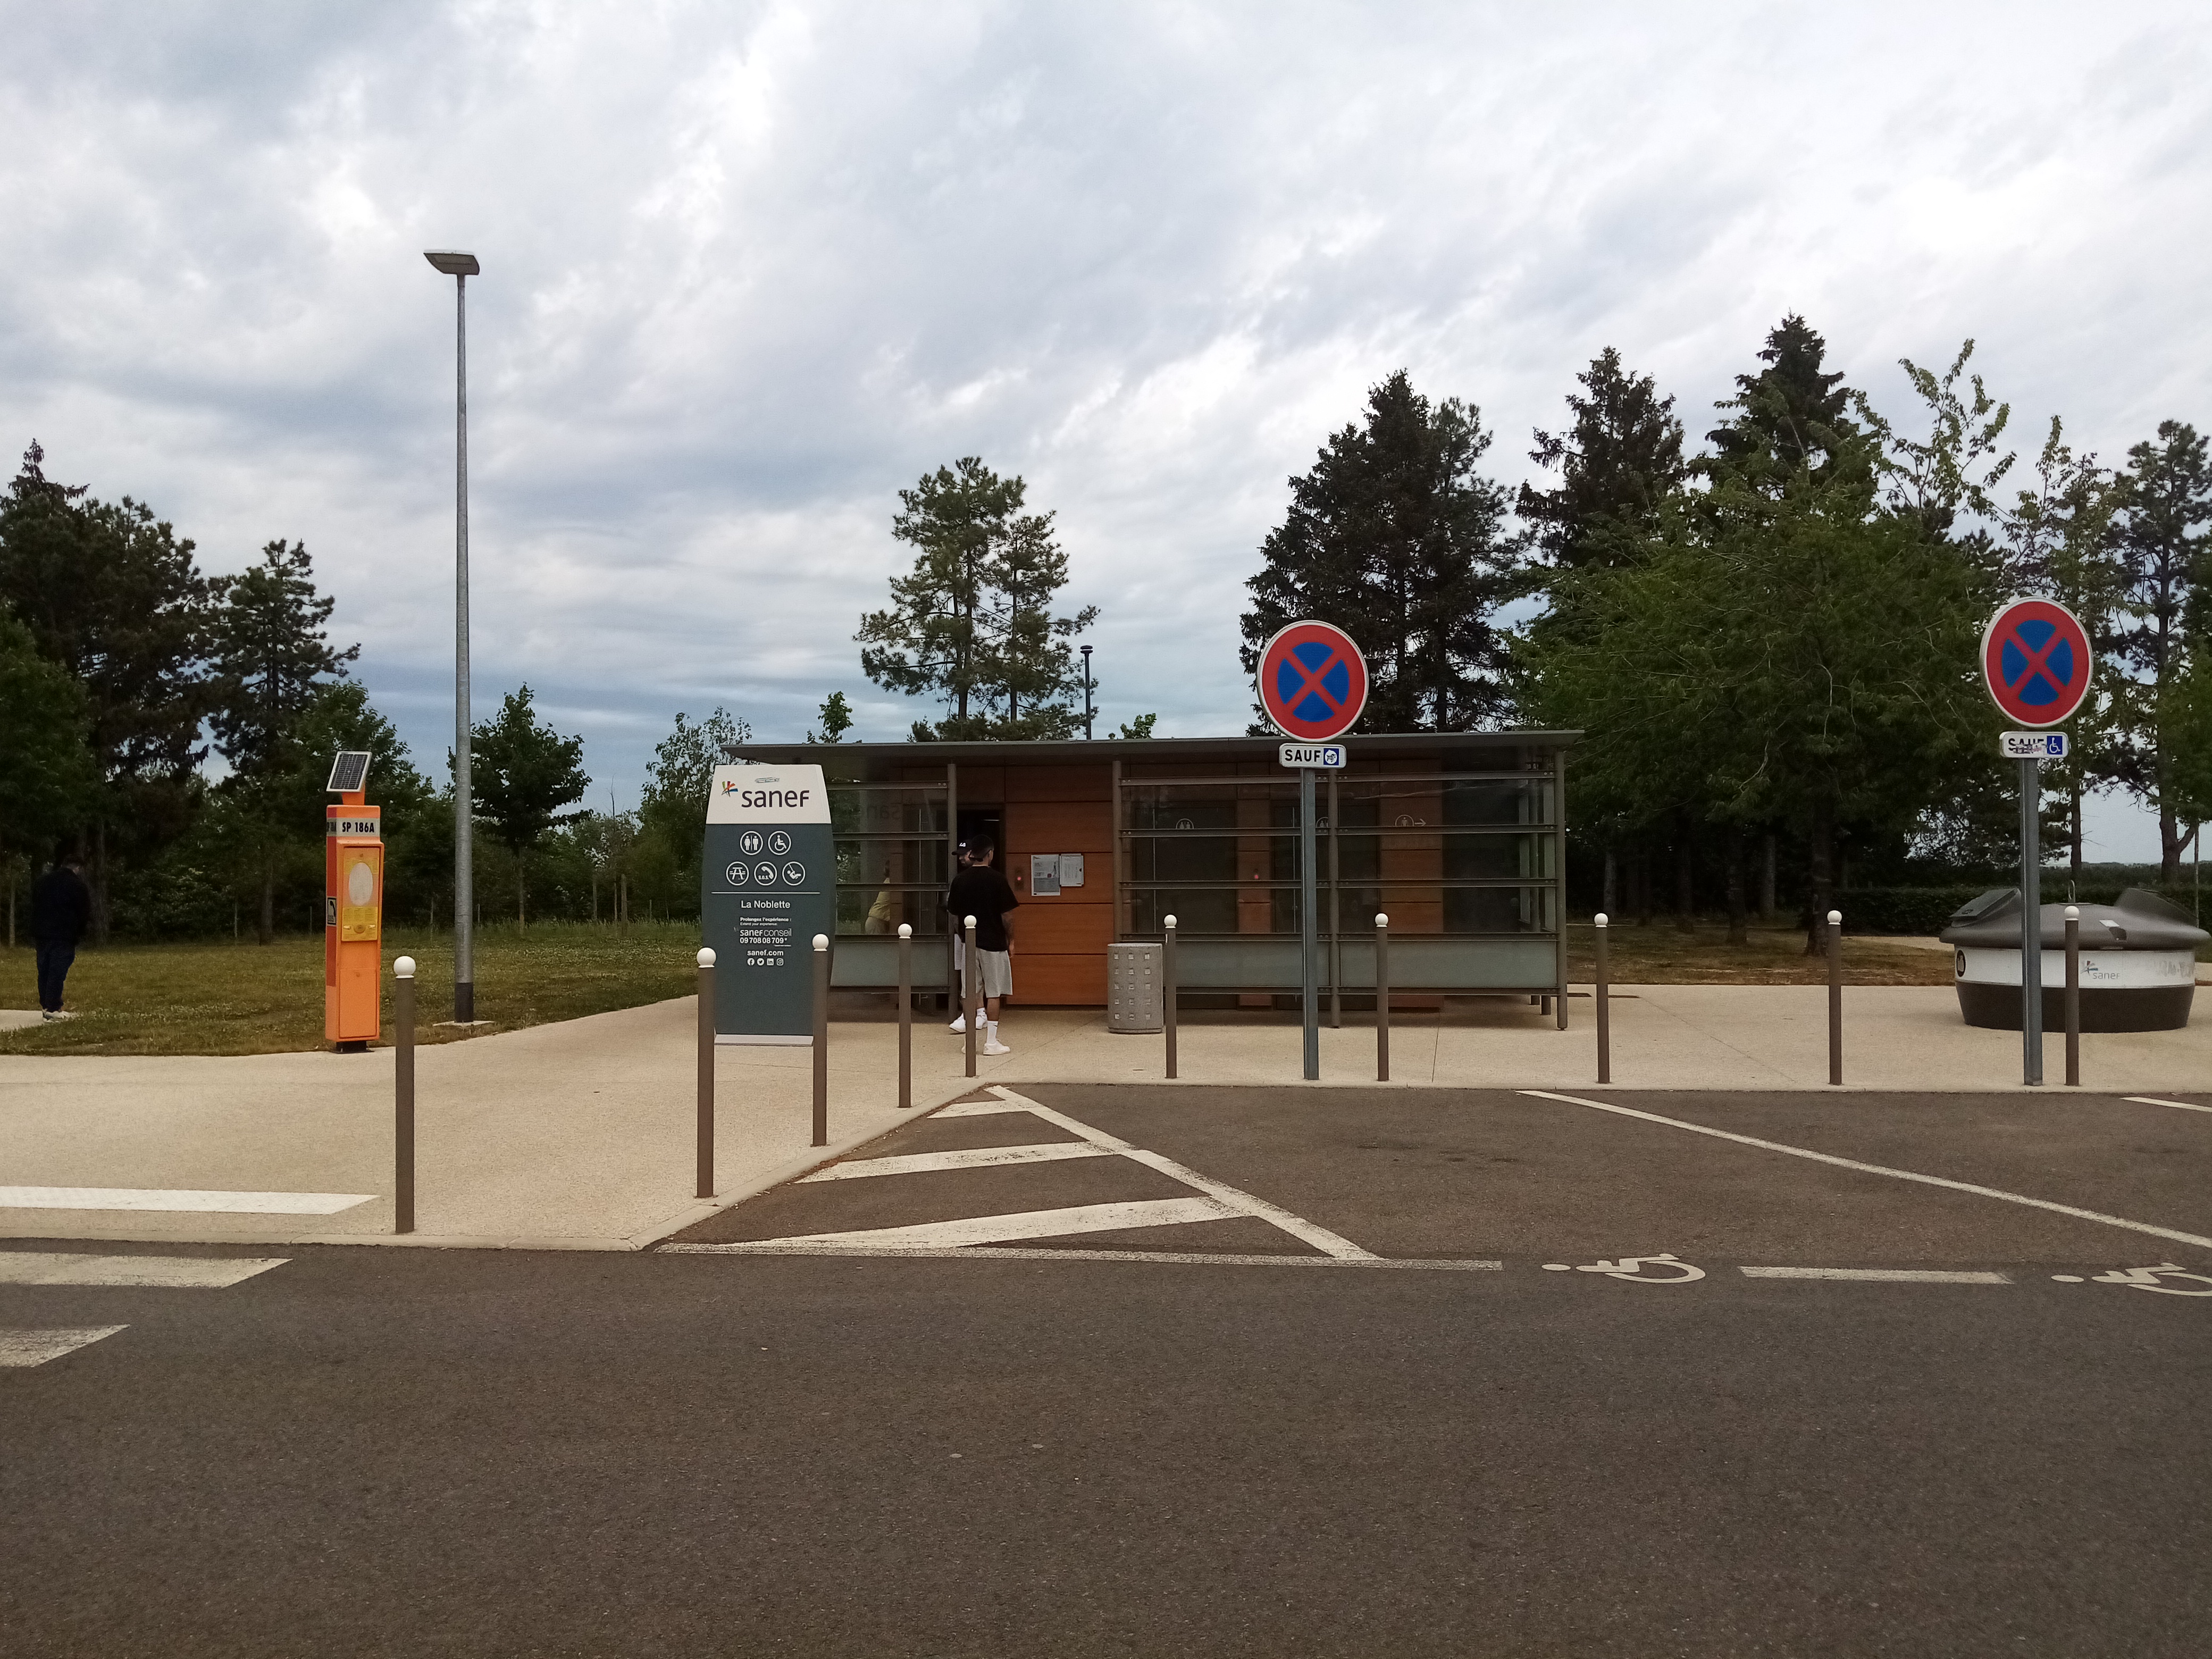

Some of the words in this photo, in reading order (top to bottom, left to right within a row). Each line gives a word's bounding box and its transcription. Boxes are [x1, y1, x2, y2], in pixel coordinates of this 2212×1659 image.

[1285, 749, 1321, 762] SAUF
[741, 790, 810, 808] sanef
[342, 822, 351, 832] SP
[355, 822, 374, 833] 186A
